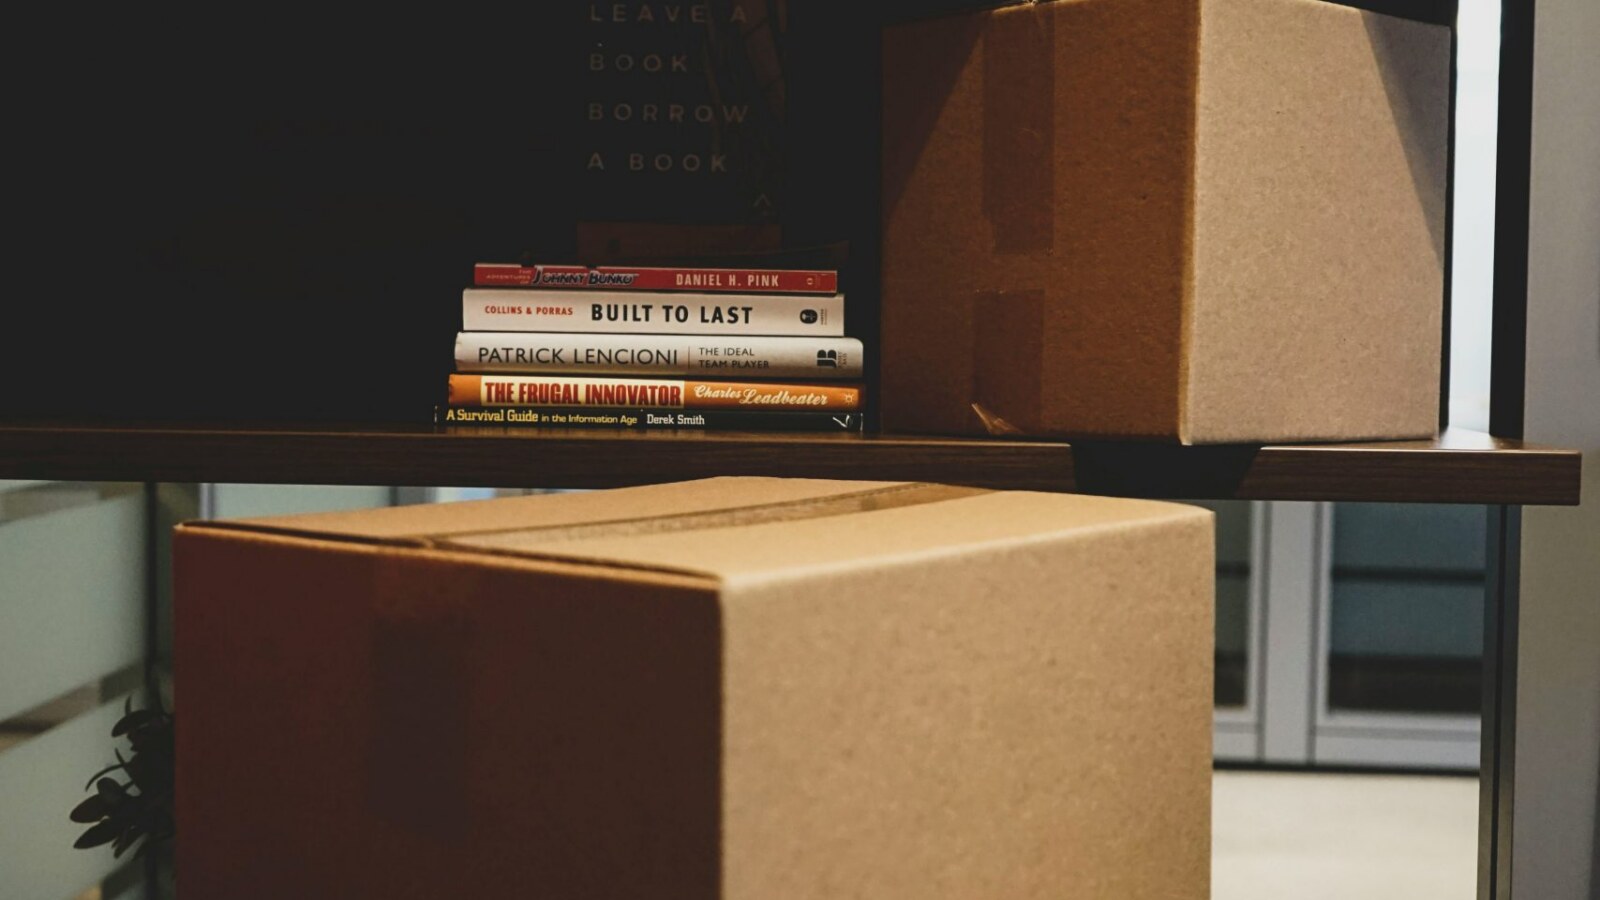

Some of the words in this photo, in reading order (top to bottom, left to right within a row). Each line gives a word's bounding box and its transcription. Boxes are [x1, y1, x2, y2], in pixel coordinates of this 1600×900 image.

[590, 4, 707, 23] LEAVE
[730, 5, 747, 23] A
[589, 53, 688, 72] BOOK
[588, 103, 749, 123] BORROW
[587, 152, 604, 170] A
[629, 153, 728, 172] BOOK
[676, 273, 722, 287] DANIEL
[729, 274, 741, 287] H.
[747, 274, 780, 287] PINK
[484, 305, 523, 315] COLLINS
[526, 306, 532, 315] &
[536, 306, 574, 316] PORRAS
[591, 303, 653, 322] BUILT
[662, 305, 689, 323] TO
[700, 306, 753, 324] LAST
[478, 347, 566, 364] PATRICK
[573, 348, 678, 365] LENCIONI
[698, 347, 719, 356] THE
[723, 347, 755, 356] IDEAL
[698, 359, 728, 368] TEAM
[731, 360, 770, 369] PLAYER
[485, 382, 515, 403] THE
[518, 382, 581, 404] FRUGAL
[585, 384, 680, 406] INNOVATOR
[693, 384, 741, 400] Charles
[739, 388, 828, 406] Leadbeater
[446, 409, 455, 421] A
[457, 409, 504, 422] Survival
[507, 409, 538, 423] Guide
[541, 414, 549, 422] in
[552, 413, 566, 423] the
[568, 414, 618, 424] Information
[620, 415, 638, 426] Age
[646, 413, 674, 425] Derek
[677, 414, 705, 426] Smith
